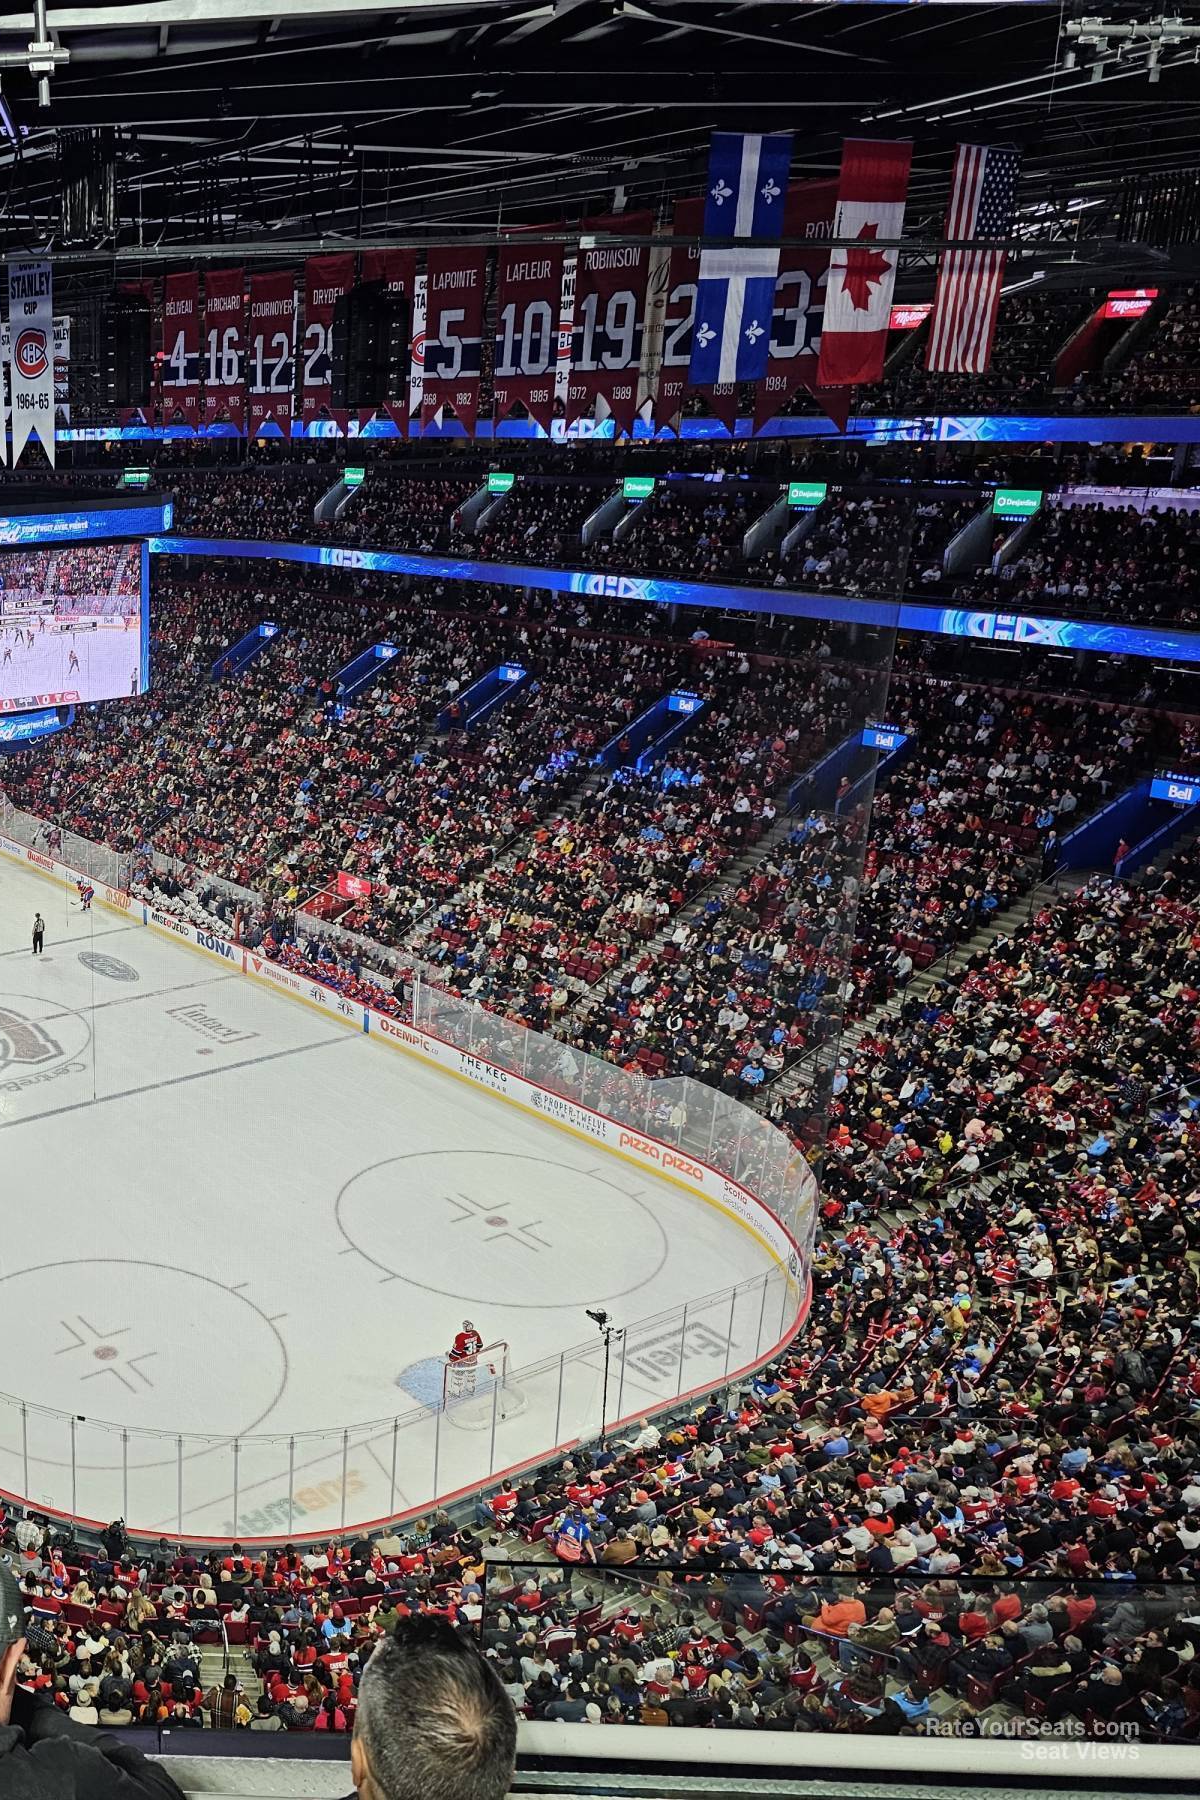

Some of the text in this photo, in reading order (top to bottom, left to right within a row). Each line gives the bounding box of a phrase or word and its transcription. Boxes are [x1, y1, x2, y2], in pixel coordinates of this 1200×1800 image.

[585, 247, 641, 271] ROBINSON
[432, 269, 478, 291] LAPOINTE
[506, 261, 551, 282] LAFLEUR
[11, 271, 50, 300] STANLEY
[24, 302, 37, 315] CUP
[207, 295, 240, 312] H.RICHARD
[251, 299, 293, 318] COURNOYER
[497, 300, 552, 377] 10
[574, 290, 637, 371] 19
[437, 308, 465, 380] 5
[170, 330, 188, 387] 4
[207, 327, 239, 385] 16
[252, 332, 289, 393] 12
[569, 386, 632, 400] 1972 1989
[765, 376, 787, 391] 1984
[16, 393, 49, 409] 1964-65
[423, 392, 472, 406] 1968 1982
[529, 390, 549, 403] 1985
[276, 405, 289, 415] 1979
[798, 490, 823, 498] Desjardins
[1006, 498, 1038, 507] Desjardins
[679, 700, 694, 711] Bell
[875, 734, 894, 747] Bell
[1168, 785, 1192, 800] Bell
[28, 850, 55, 869] Qualinet
[113, 892, 131, 909] SKIP
[197, 931, 235, 960] RONA
[264, 967, 300, 990] CANADIAN TIRE
[459, 1053, 507, 1082] THE KEG
[544, 1096, 608, 1132] PROPER TWELVE
[569, 1118, 607, 1137] WHISKEY
[619, 1132, 704, 1182] pizza pizza
[724, 1181, 748, 1205] Scotia
[722, 1194, 746, 1218] Gestion
